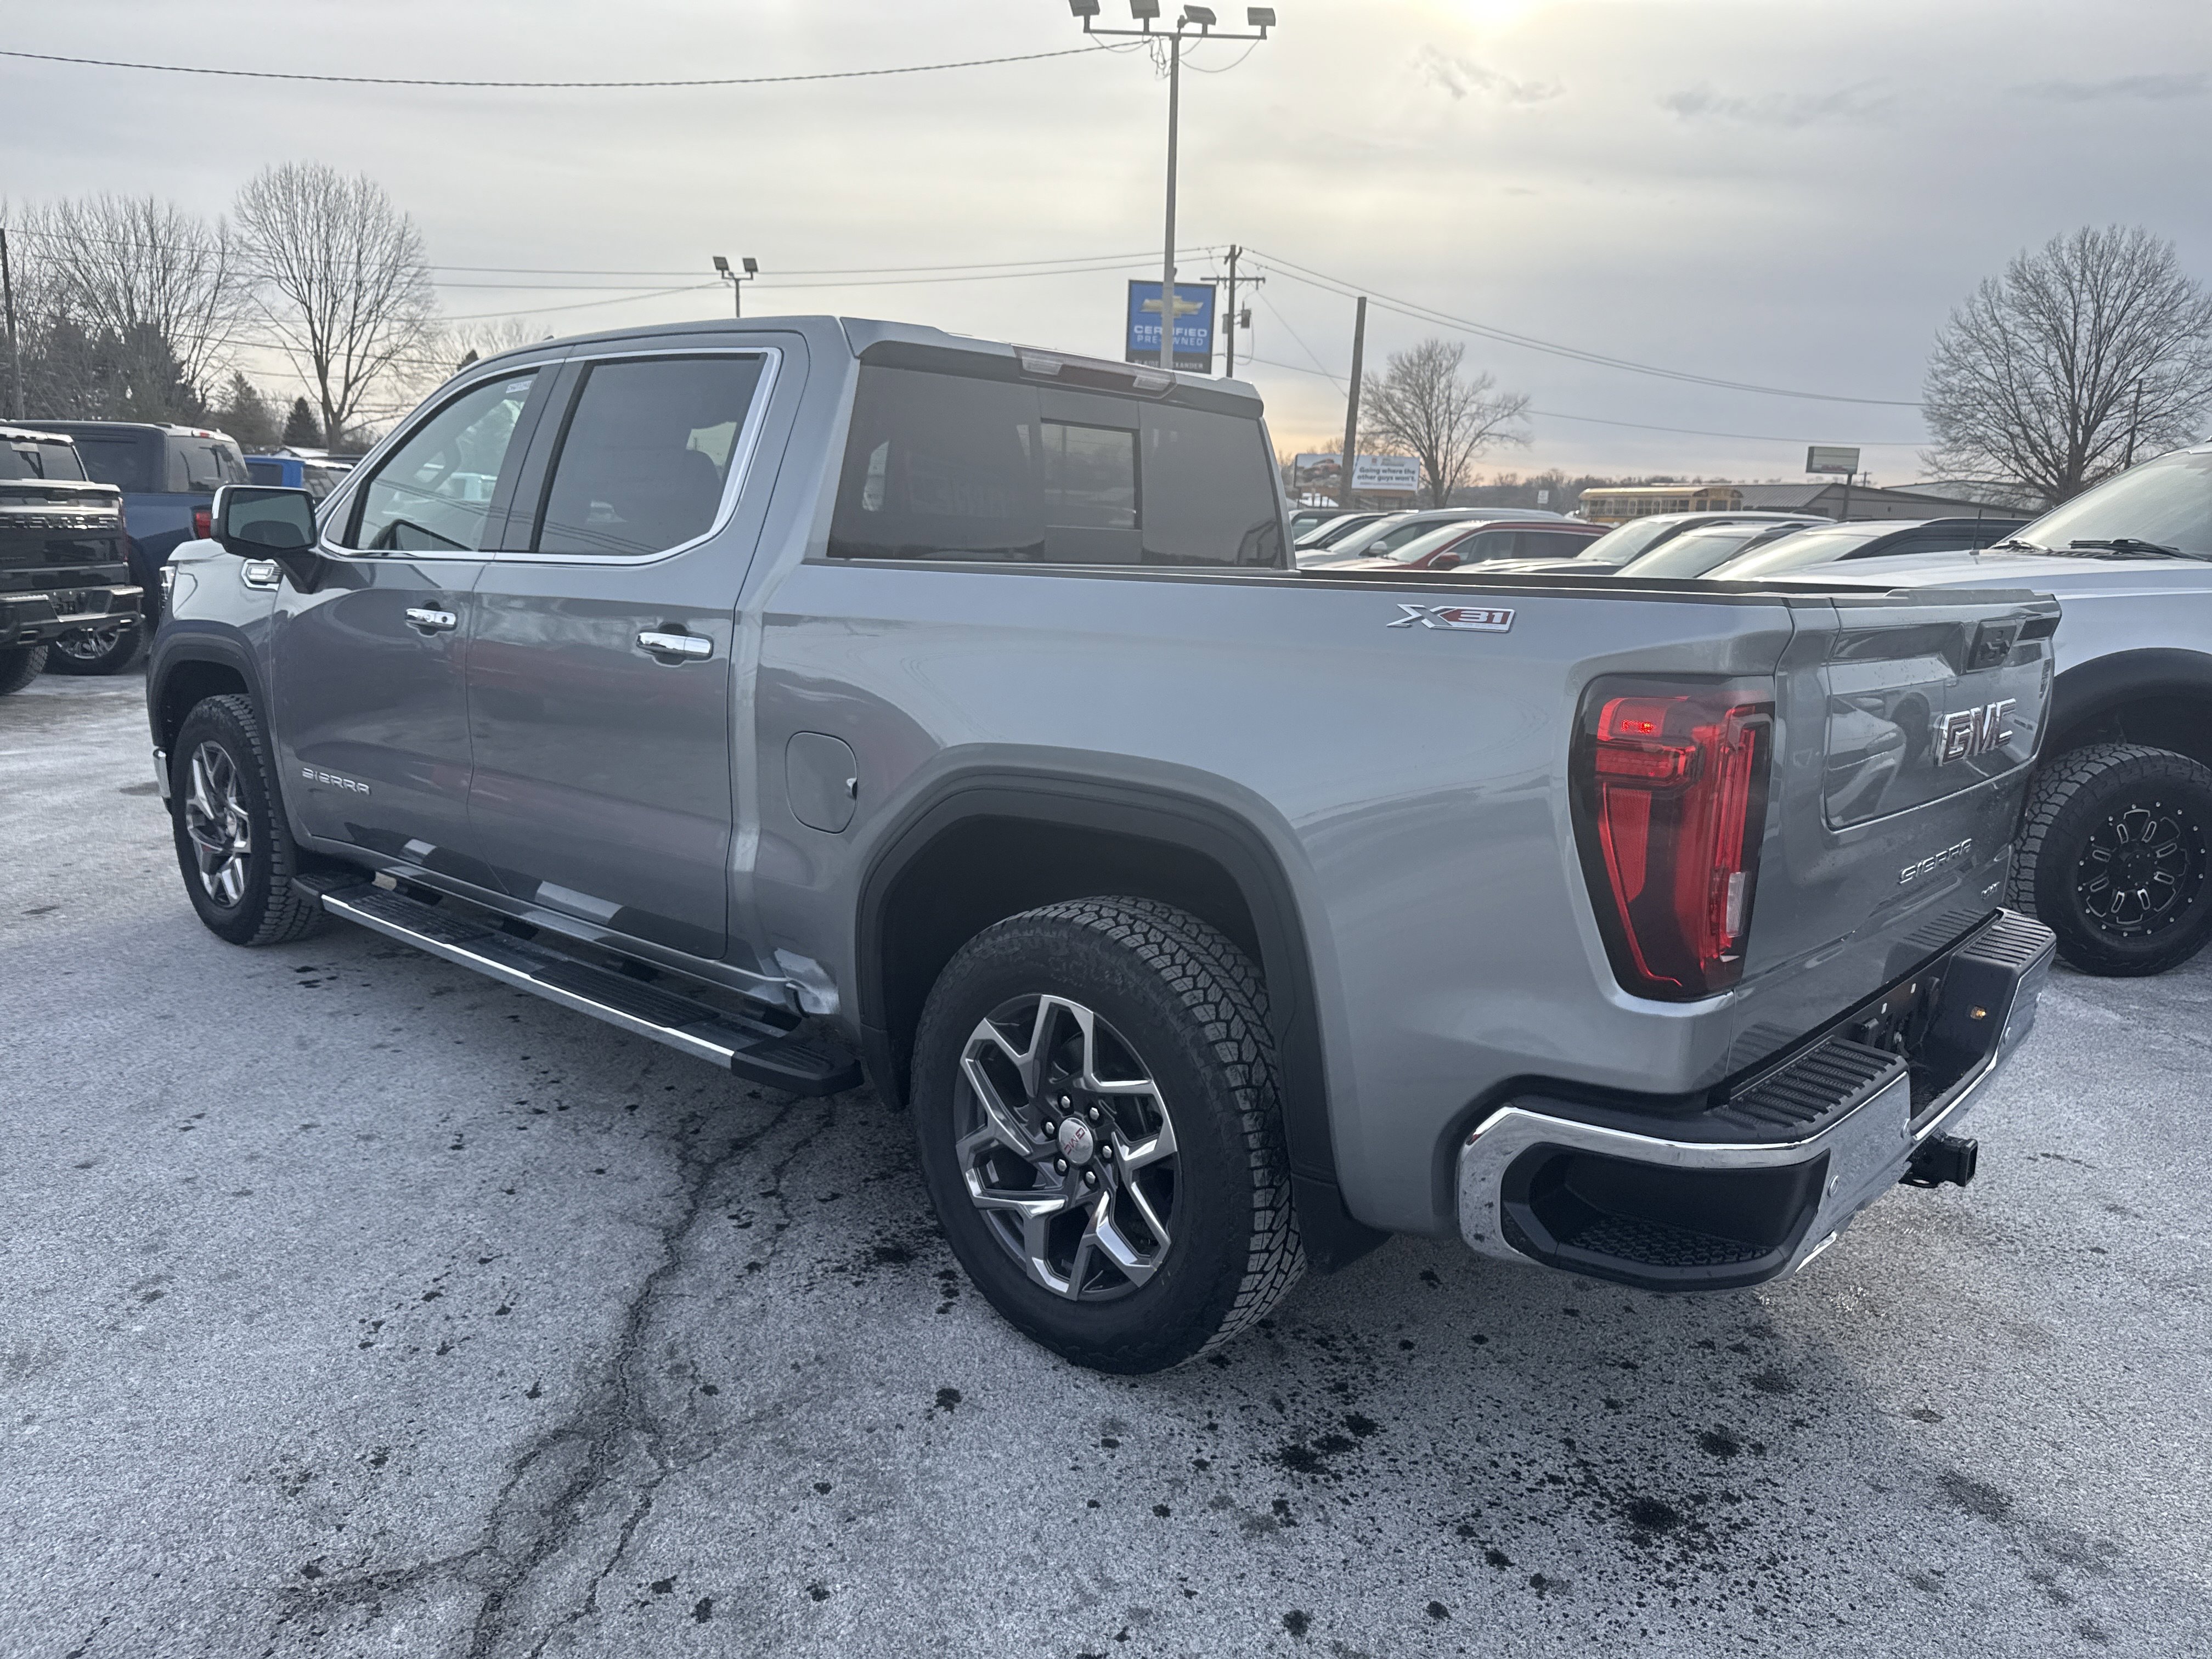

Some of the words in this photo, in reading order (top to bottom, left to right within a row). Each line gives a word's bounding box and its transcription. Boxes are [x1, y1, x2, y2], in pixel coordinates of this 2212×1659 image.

[1134, 325, 1207, 337] CERIFIED
[1137, 334, 1203, 346] PRE-WNED
[1359, 466, 1380, 475] Going
[1933, 698, 2016, 766] GMC
[302, 768, 370, 795] SIERRA
[1898, 838, 1972, 884] SIERRA
[1064, 1127, 1085, 1155] GMC
